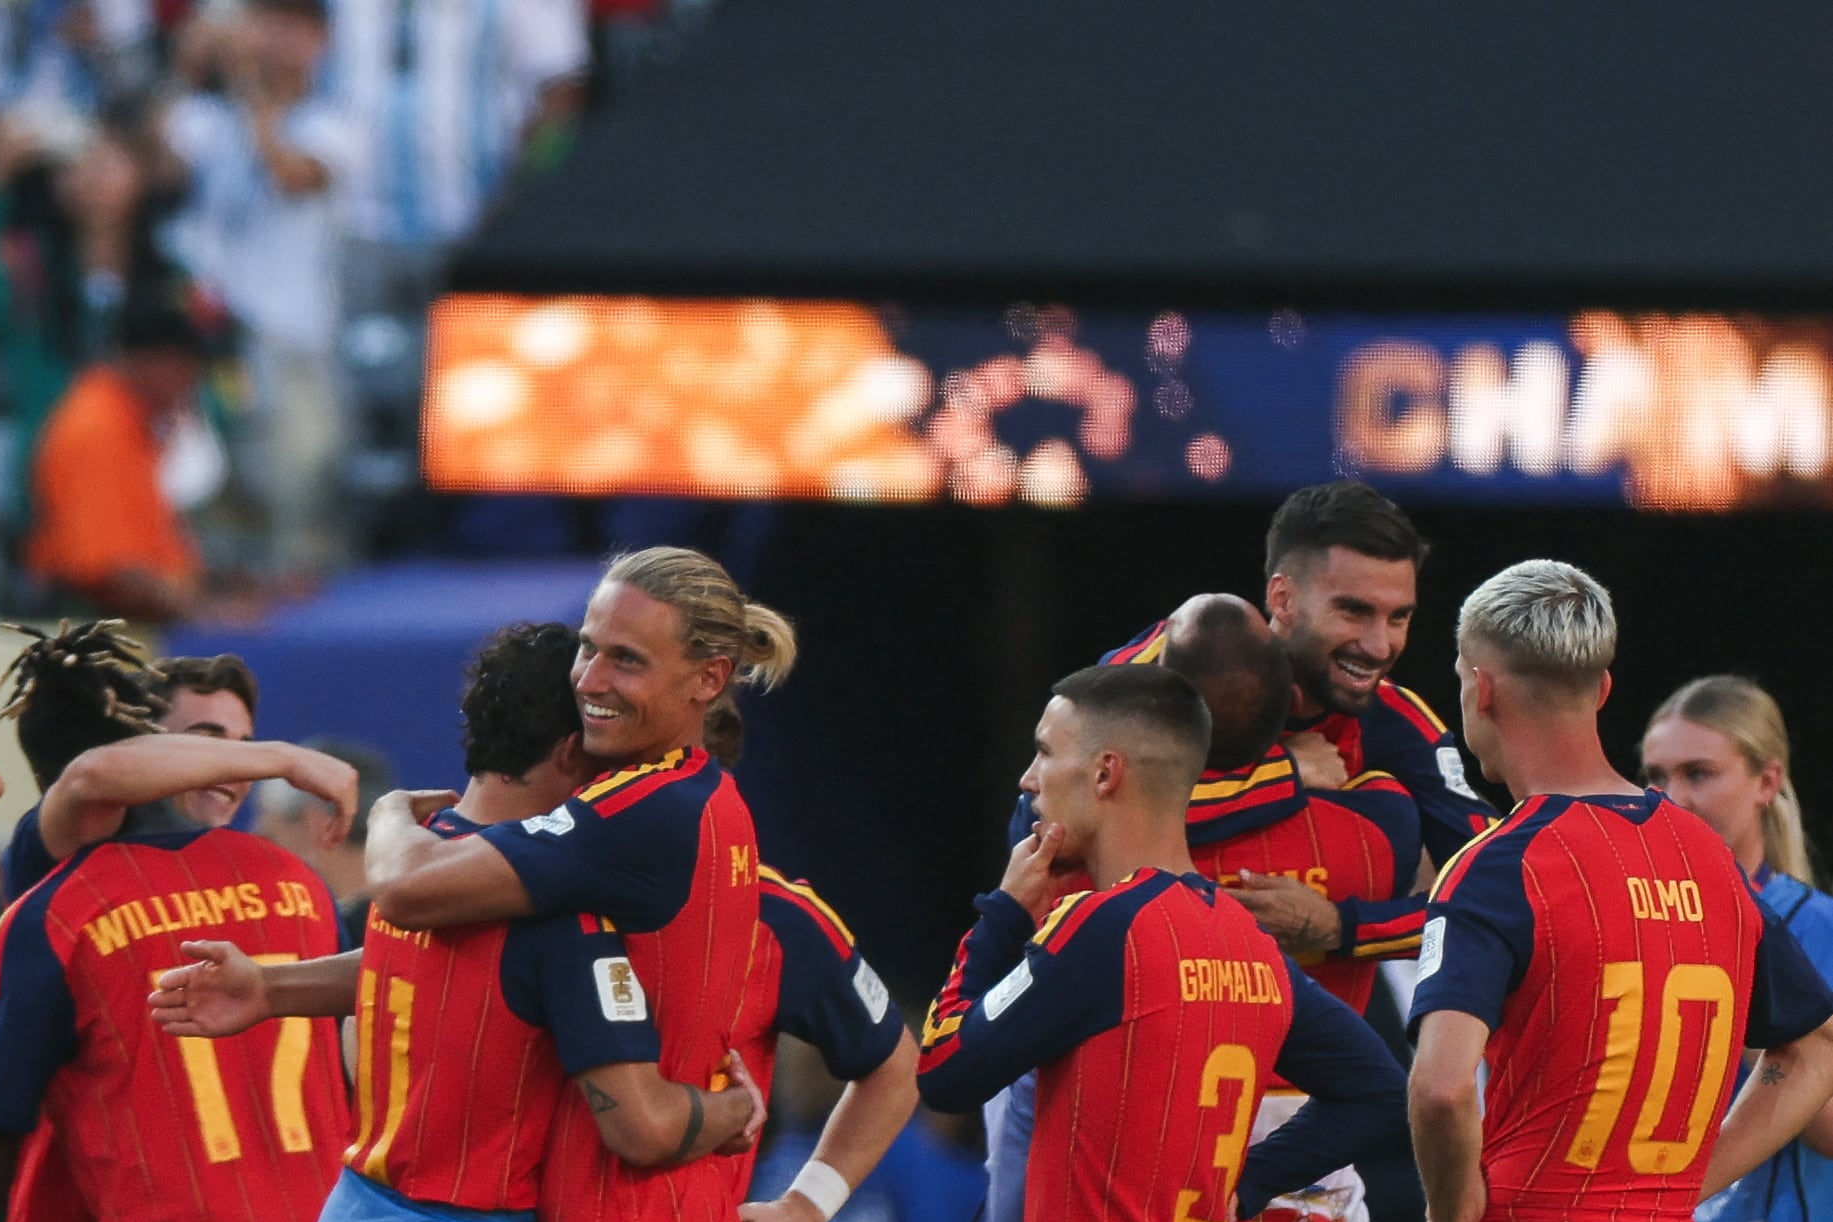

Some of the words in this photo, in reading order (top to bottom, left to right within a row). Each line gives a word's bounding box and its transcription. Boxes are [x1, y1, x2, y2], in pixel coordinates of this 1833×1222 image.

[85, 882, 267, 956] WILLIAMS
[1627, 877, 1704, 922] OLMO
[1179, 958, 1282, 1005] GRIMALDO
[149, 953, 313, 1163] 17
[343, 969, 415, 1179] 11
[1565, 960, 1735, 1175] 10
